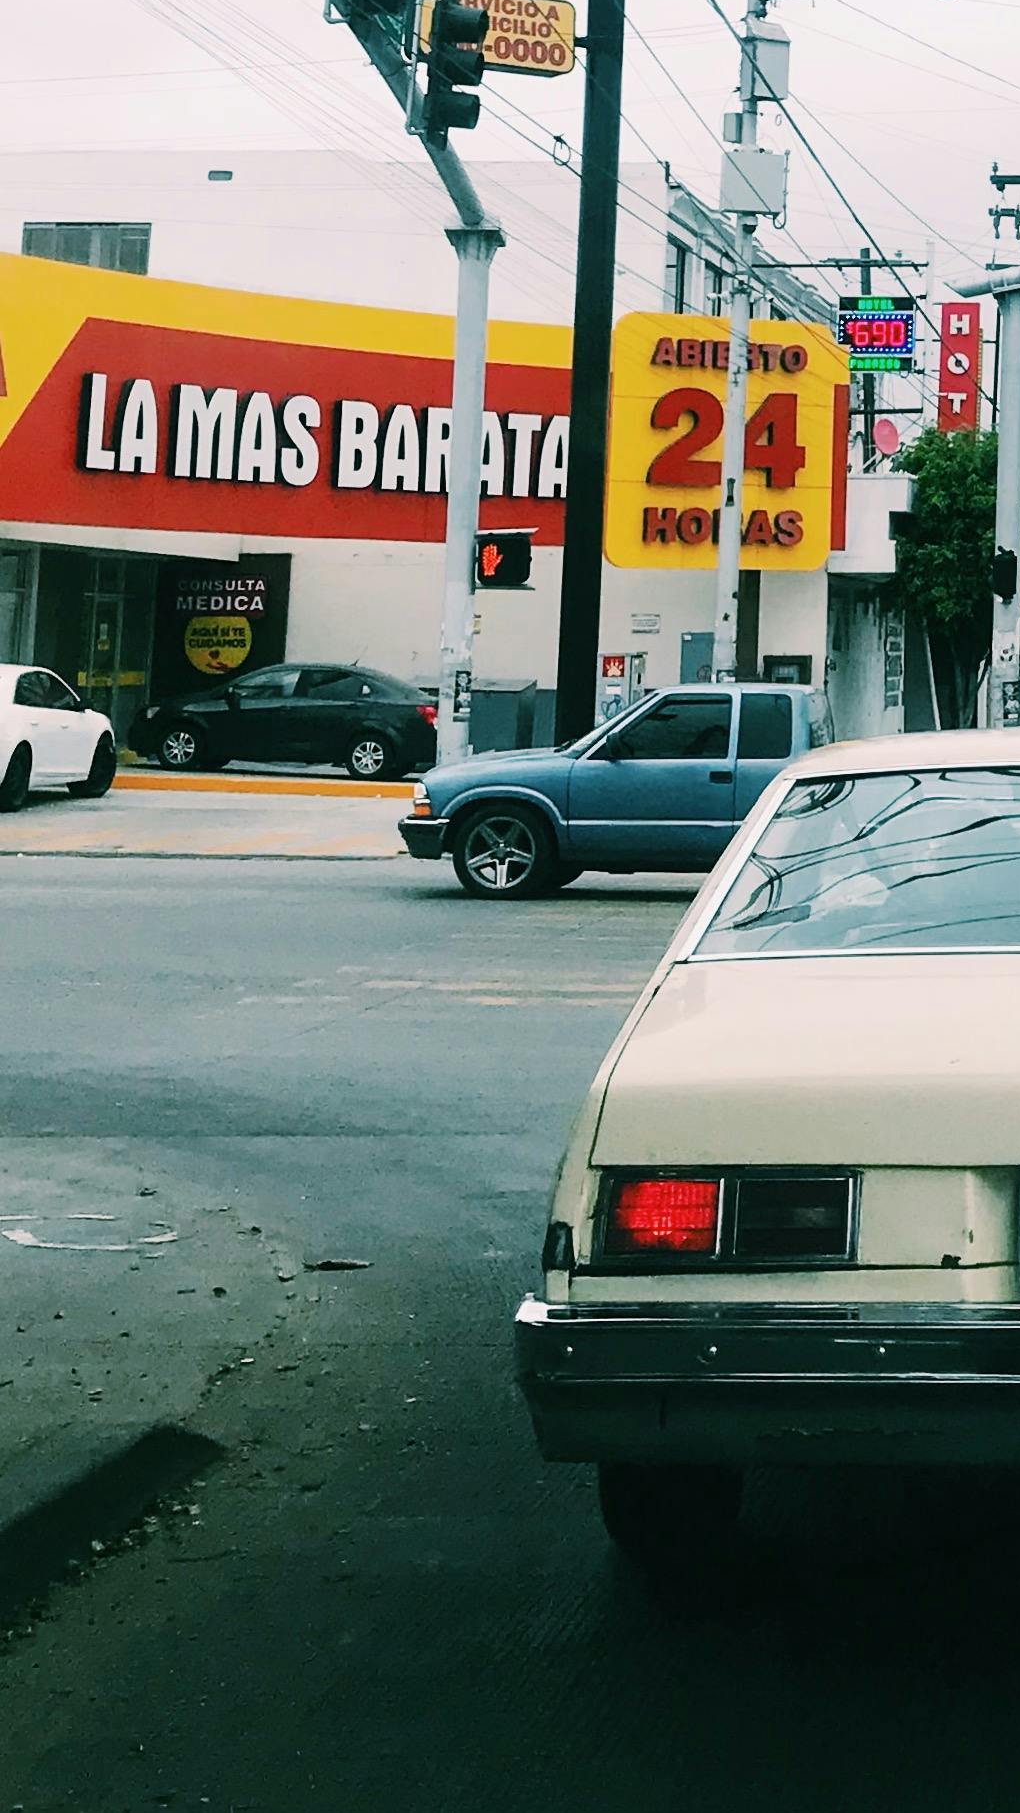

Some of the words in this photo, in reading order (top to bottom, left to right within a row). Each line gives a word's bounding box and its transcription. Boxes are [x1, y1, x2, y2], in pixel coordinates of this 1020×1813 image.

[545, 5, 560, 22] A
[491, 15, 551, 38] ICILIO
[82, 372, 158, 474] LA
[174, 382, 321, 488] MAS
[646, 387, 806, 488] 24
[642, 506, 805, 547] HOAS
[179, 579, 265, 591] CONSULTA
[176, 595, 264, 611] MEDICA
